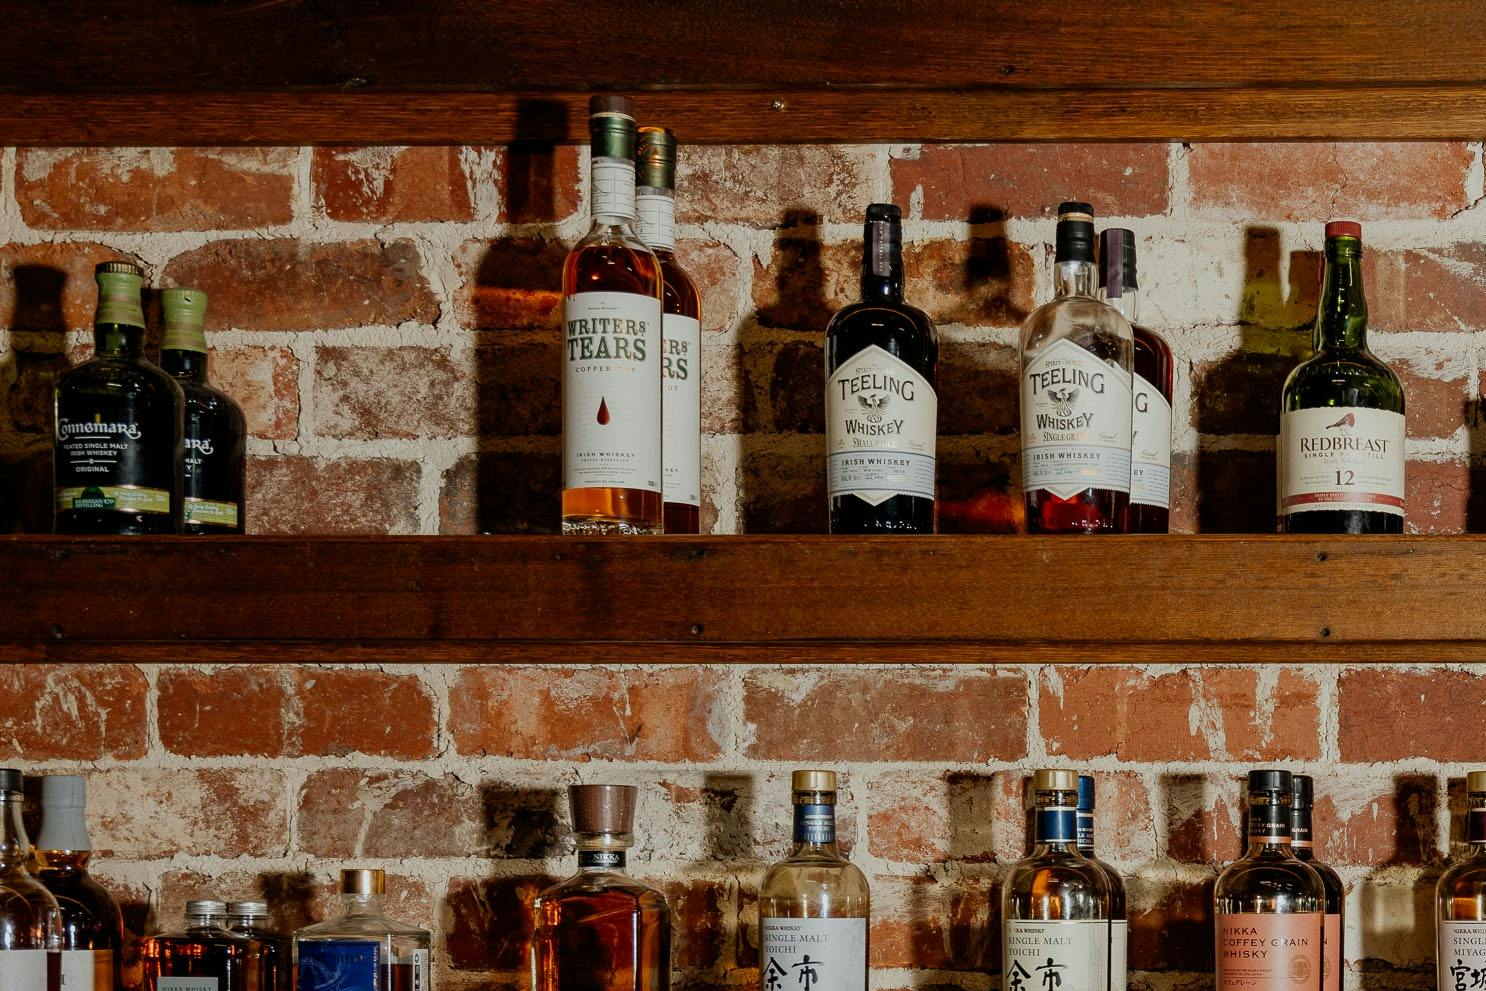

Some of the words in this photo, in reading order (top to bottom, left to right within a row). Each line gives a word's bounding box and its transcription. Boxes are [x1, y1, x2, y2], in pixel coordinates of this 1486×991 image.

[567, 336, 646, 362] TEARS
[838, 374, 914, 401] TEELING
[1030, 368, 1104, 395] TEELING
[59, 418, 141, 441] Connemara
[845, 420, 904, 436] WHISKEY
[1036, 413, 1094, 430] WHISKEY
[1300, 437, 1387, 453] REDBREAST
[1335, 470, 1355, 485] 12
[1271, 938, 1308, 946] GRAIN
